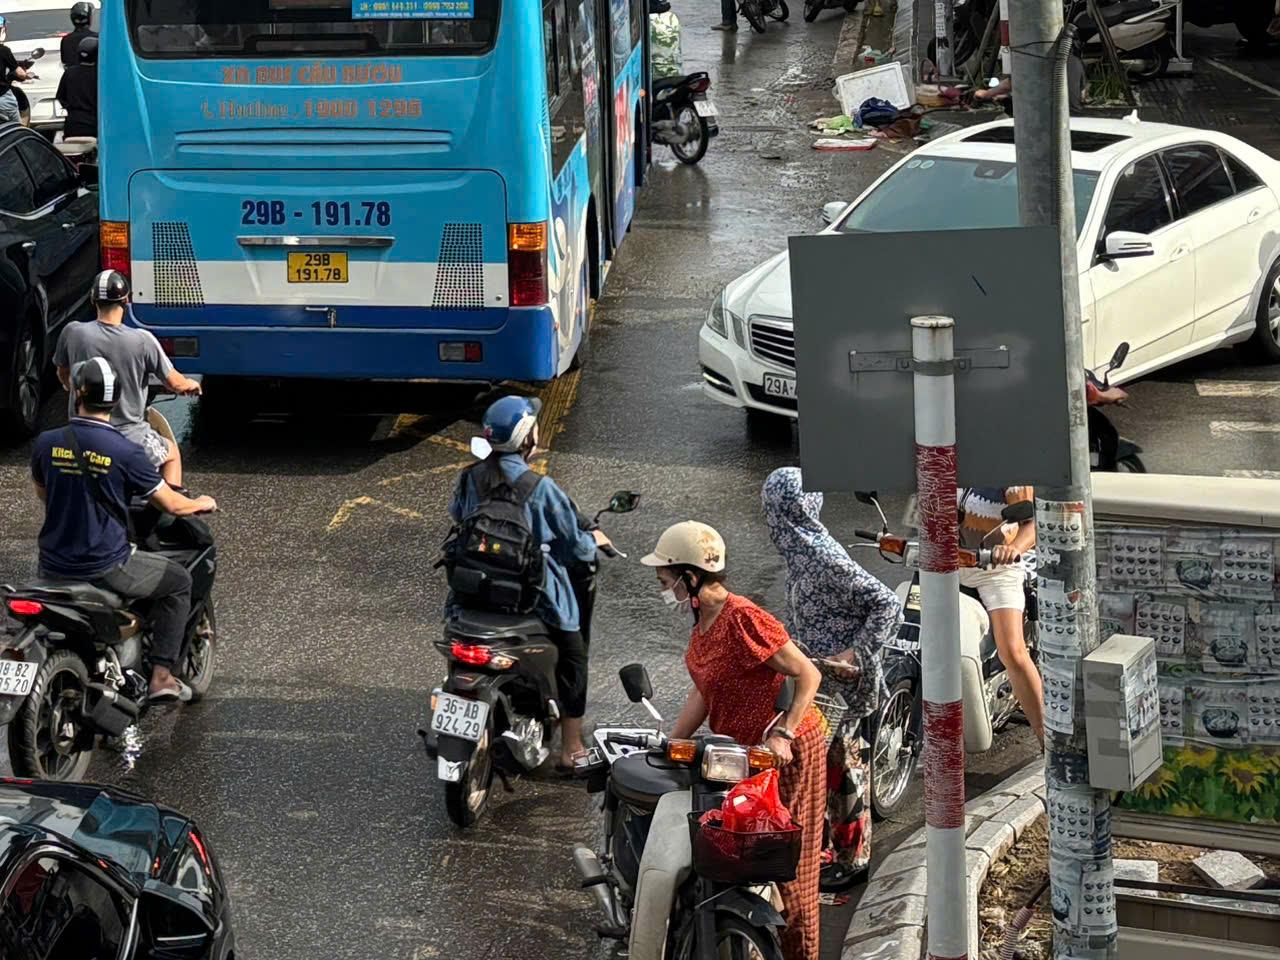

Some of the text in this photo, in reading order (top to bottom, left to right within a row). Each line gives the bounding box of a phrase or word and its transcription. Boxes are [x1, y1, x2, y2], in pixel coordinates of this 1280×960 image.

[241, 199, 286, 226] 29B
[310, 200, 391, 227] 191.78
[304, 253, 331, 267] 29B
[295, 267, 342, 281] 191.78
[89, 451, 112, 467] Care
[442, 697, 480, 720] 36-AB
[435, 713, 480, 738] 924.29
